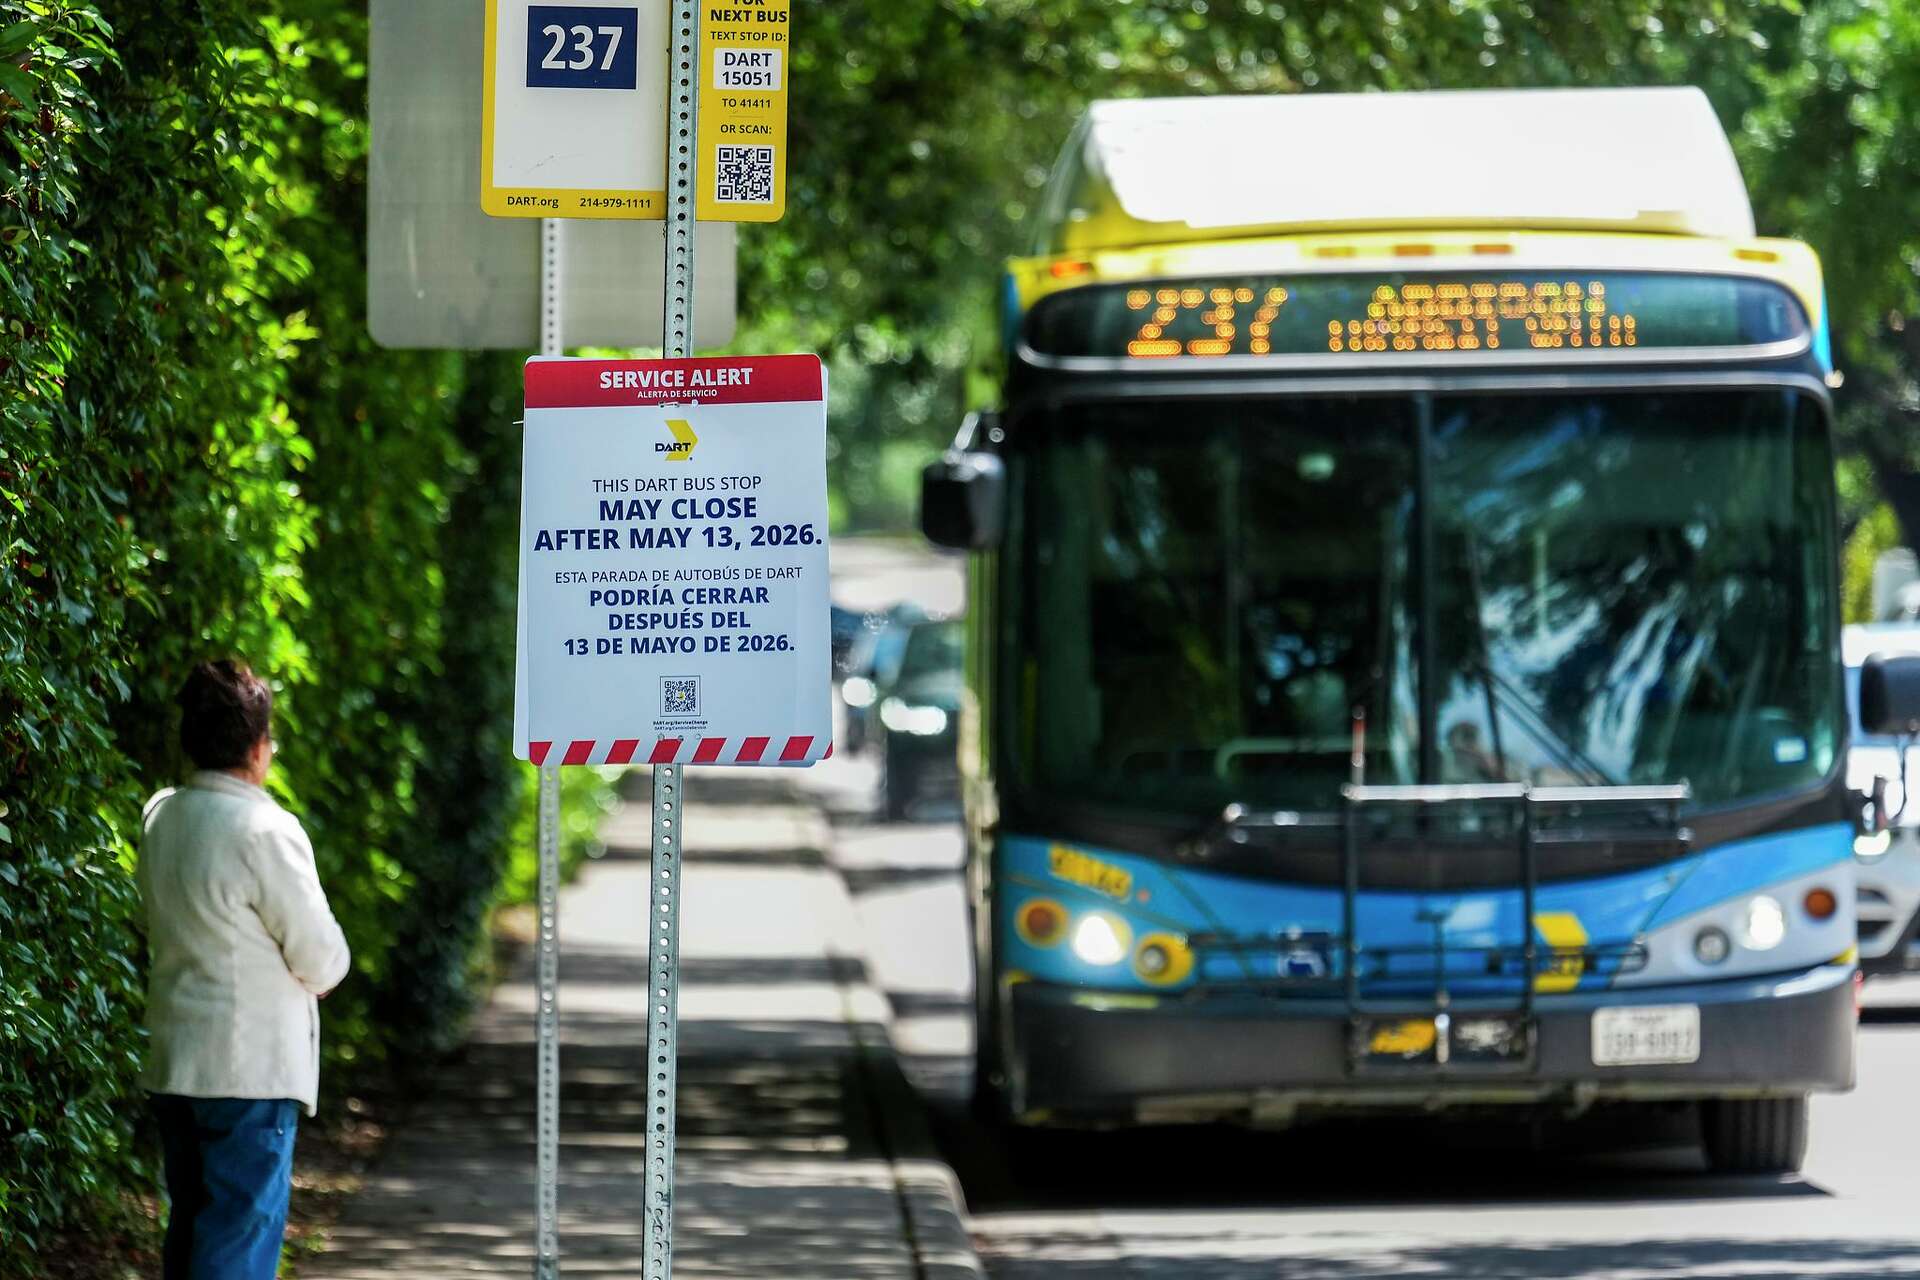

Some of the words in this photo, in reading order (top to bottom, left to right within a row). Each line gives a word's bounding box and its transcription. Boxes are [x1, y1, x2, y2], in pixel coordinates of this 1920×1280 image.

[711, 9, 752, 22] NEXT
[757, 11, 787, 22] BUS
[710, 31, 737, 40] TEXT
[740, 32, 768, 41] STOP
[772, 33, 786, 41] ID:
[541, 24, 623, 71] 237
[724, 52, 772, 68] DART
[722, 71, 772, 86] 15051
[722, 98, 737, 108] TO
[740, 98, 771, 109] 41411
[720, 124, 737, 134] OR
[739, 124, 772, 135] SCAN:
[507, 196, 559, 209] DART.org
[580, 198, 651, 209] 214-979-1111
[1126, 286, 1288, 358] 237
[600, 370, 685, 389] SERVICE
[690, 368, 753, 387] ALERT
[637, 390, 668, 399] ALERTA
[670, 389, 681, 398] DE
[682, 388, 718, 398] SERVICIO
[655, 442, 691, 452] DART
[593, 479, 629, 493] THIS
[635, 478, 678, 492] DART
[683, 476, 715, 491] BUS
[720, 475, 762, 490] STOP
[600, 499, 663, 521] MAY
[671, 497, 757, 519] CLOSE
[534, 528, 620, 551] AFTER
[630, 527, 692, 549] MAY
[702, 526, 741, 550] 13,
[750, 524, 822, 547] 2026.
[555, 571, 589, 584] ESTA
[592, 570, 648, 583] PARADA
[652, 569, 670, 582] DE
[674, 566, 740, 581] AUTOBÚS
[744, 568, 762, 580] DE
[767, 566, 803, 579] DART
[590, 584, 675, 607] PODRÍA
[681, 586, 770, 605] CERRAR
[608, 607, 703, 631] DESPUÉS
[711, 611, 751, 629] DEL
[564, 638, 589, 655] 13
[596, 637, 623, 654] DE
[630, 636, 696, 654] MAYO
[704, 635, 731, 653] DE
[737, 634, 795, 652] 2026.
